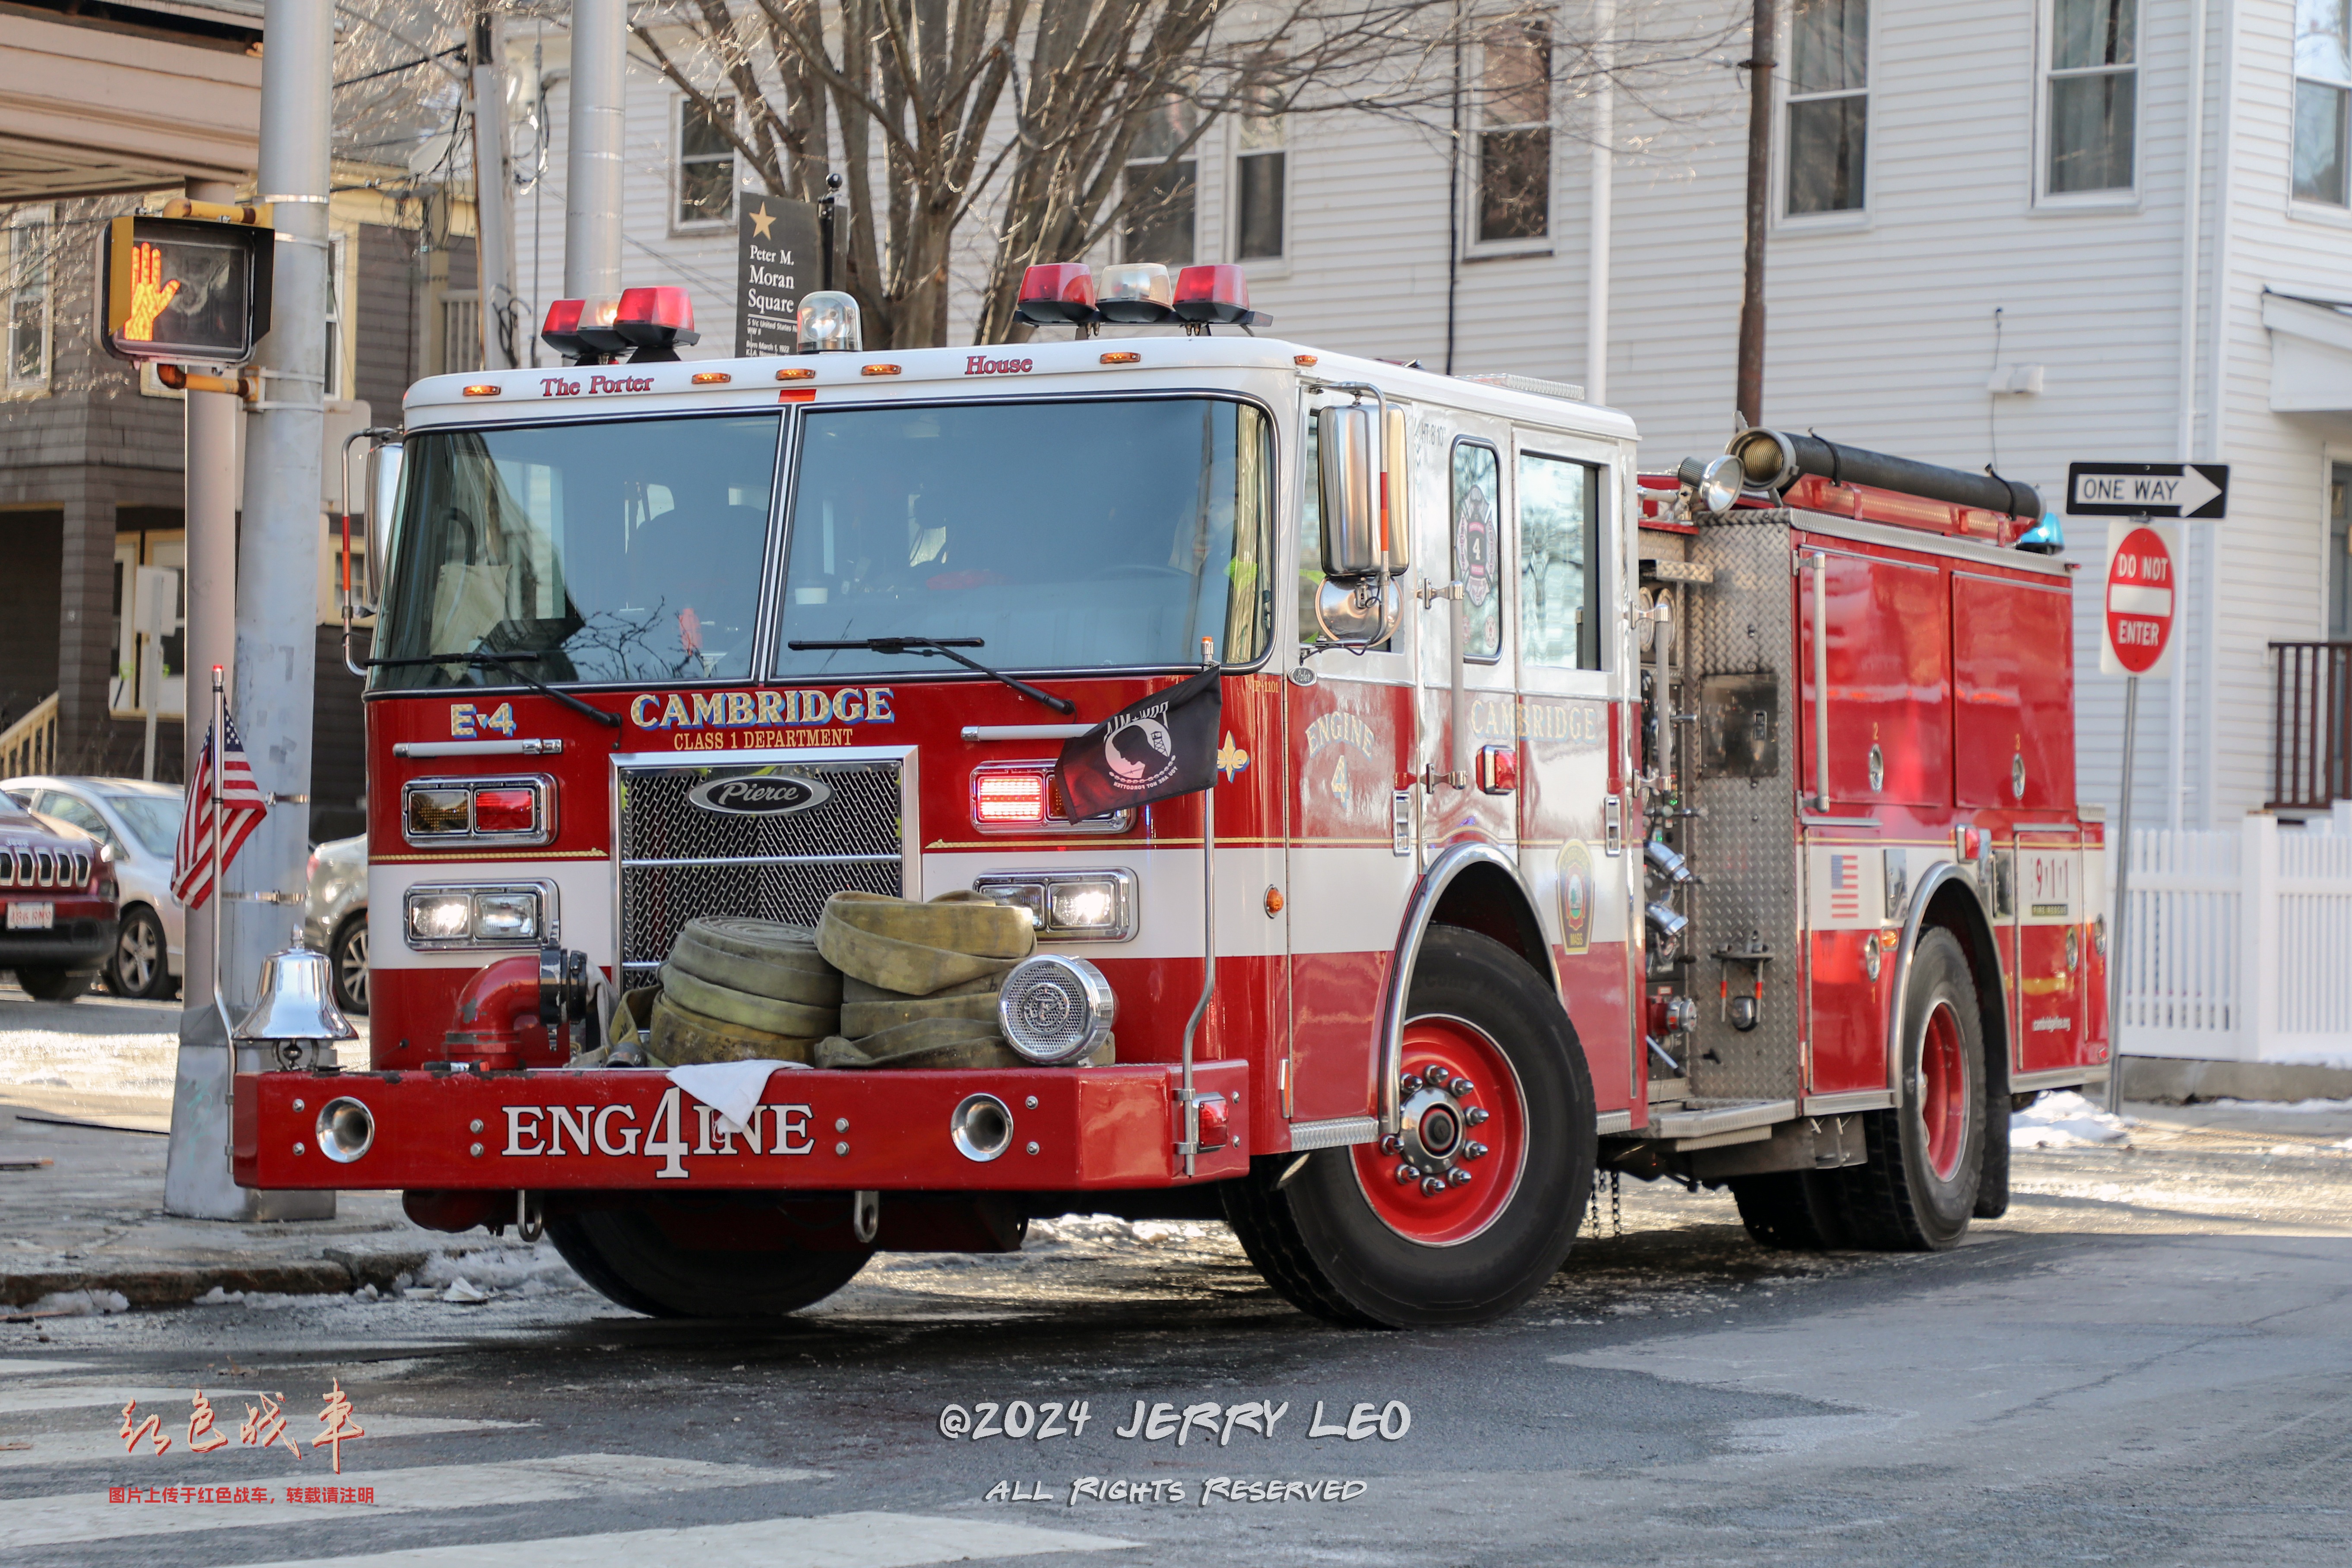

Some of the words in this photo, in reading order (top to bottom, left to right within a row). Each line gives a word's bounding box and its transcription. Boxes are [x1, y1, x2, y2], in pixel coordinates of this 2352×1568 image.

[750, 244, 777, 263] Peter
[780, 250, 794, 266] M.
[749, 264, 795, 290] Moran
[748, 288, 794, 314] Square
[760, 320, 776, 329] United
[777, 322, 792, 332] States
[758, 342, 774, 351] March
[964, 355, 1033, 375] House
[540, 377, 580, 396] The
[589, 375, 655, 394] Porter
[2083, 478, 2125, 500] ONE
[2135, 479, 2180, 501] WAY
[1473, 538, 1481, 561] 4
[2118, 553, 2136, 579] DO
[2142, 555, 2169, 581] NOT
[2118, 620, 2159, 646] ENTER
[631, 687, 895, 730] CAMBRIDGE
[1471, 700, 1597, 744] CAMBRIDGE
[1873, 722, 1879, 740] 2
[674, 733, 724, 751] CLASS
[731, 732, 738, 749] 1
[744, 729, 853, 748] DEPARTMENT
[1305, 711, 1375, 762] ENGINE
[718, 781, 799, 805] Pierce
[1331, 755, 1349, 808] 4
[1570, 933, 1583, 946] MASS
